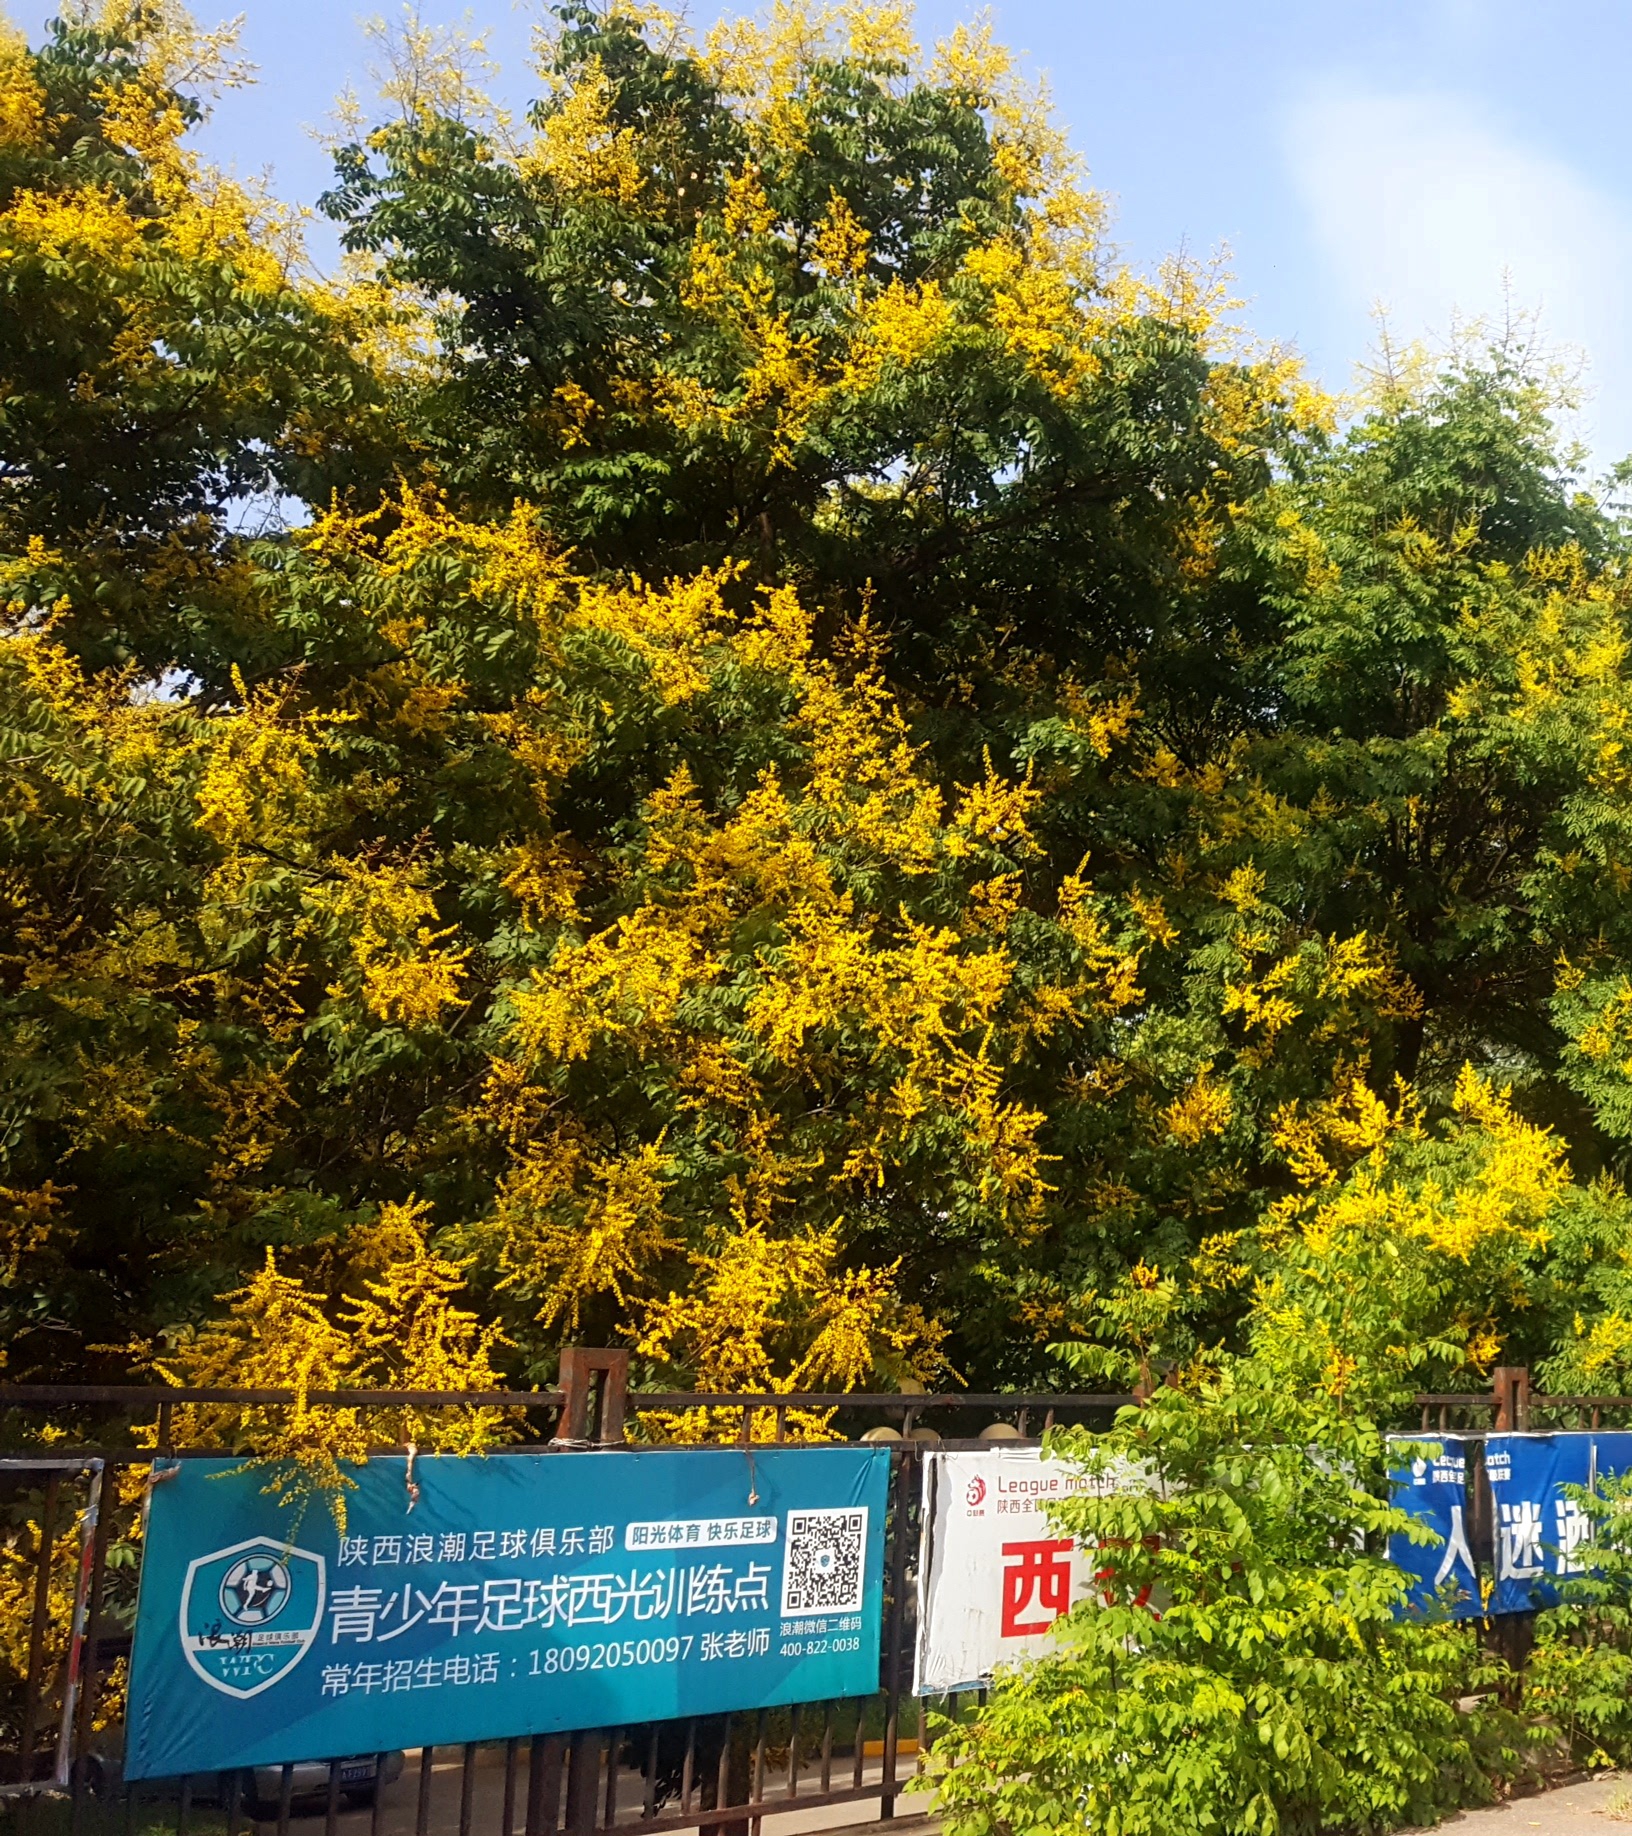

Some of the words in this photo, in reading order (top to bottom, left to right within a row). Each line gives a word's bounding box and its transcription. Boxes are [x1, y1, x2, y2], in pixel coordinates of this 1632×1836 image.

[1485, 1451, 1512, 1466] atch
[998, 1475, 1058, 1495] League
[1065, 1473, 1116, 1491] match
[632, 1524, 701, 1545] 阳光体育
[707, 1520, 771, 1541] 快乐足球
[337, 1525, 615, 1567] 陕西浪潮足球俱乐部
[328, 1561, 772, 1645] 青少年足球西光训练点
[780, 1616, 862, 1637] 浪潮微信二维码
[700, 1628, 771, 1662] 张老师
[780, 1637, 860, 1658] 400-822-0038
